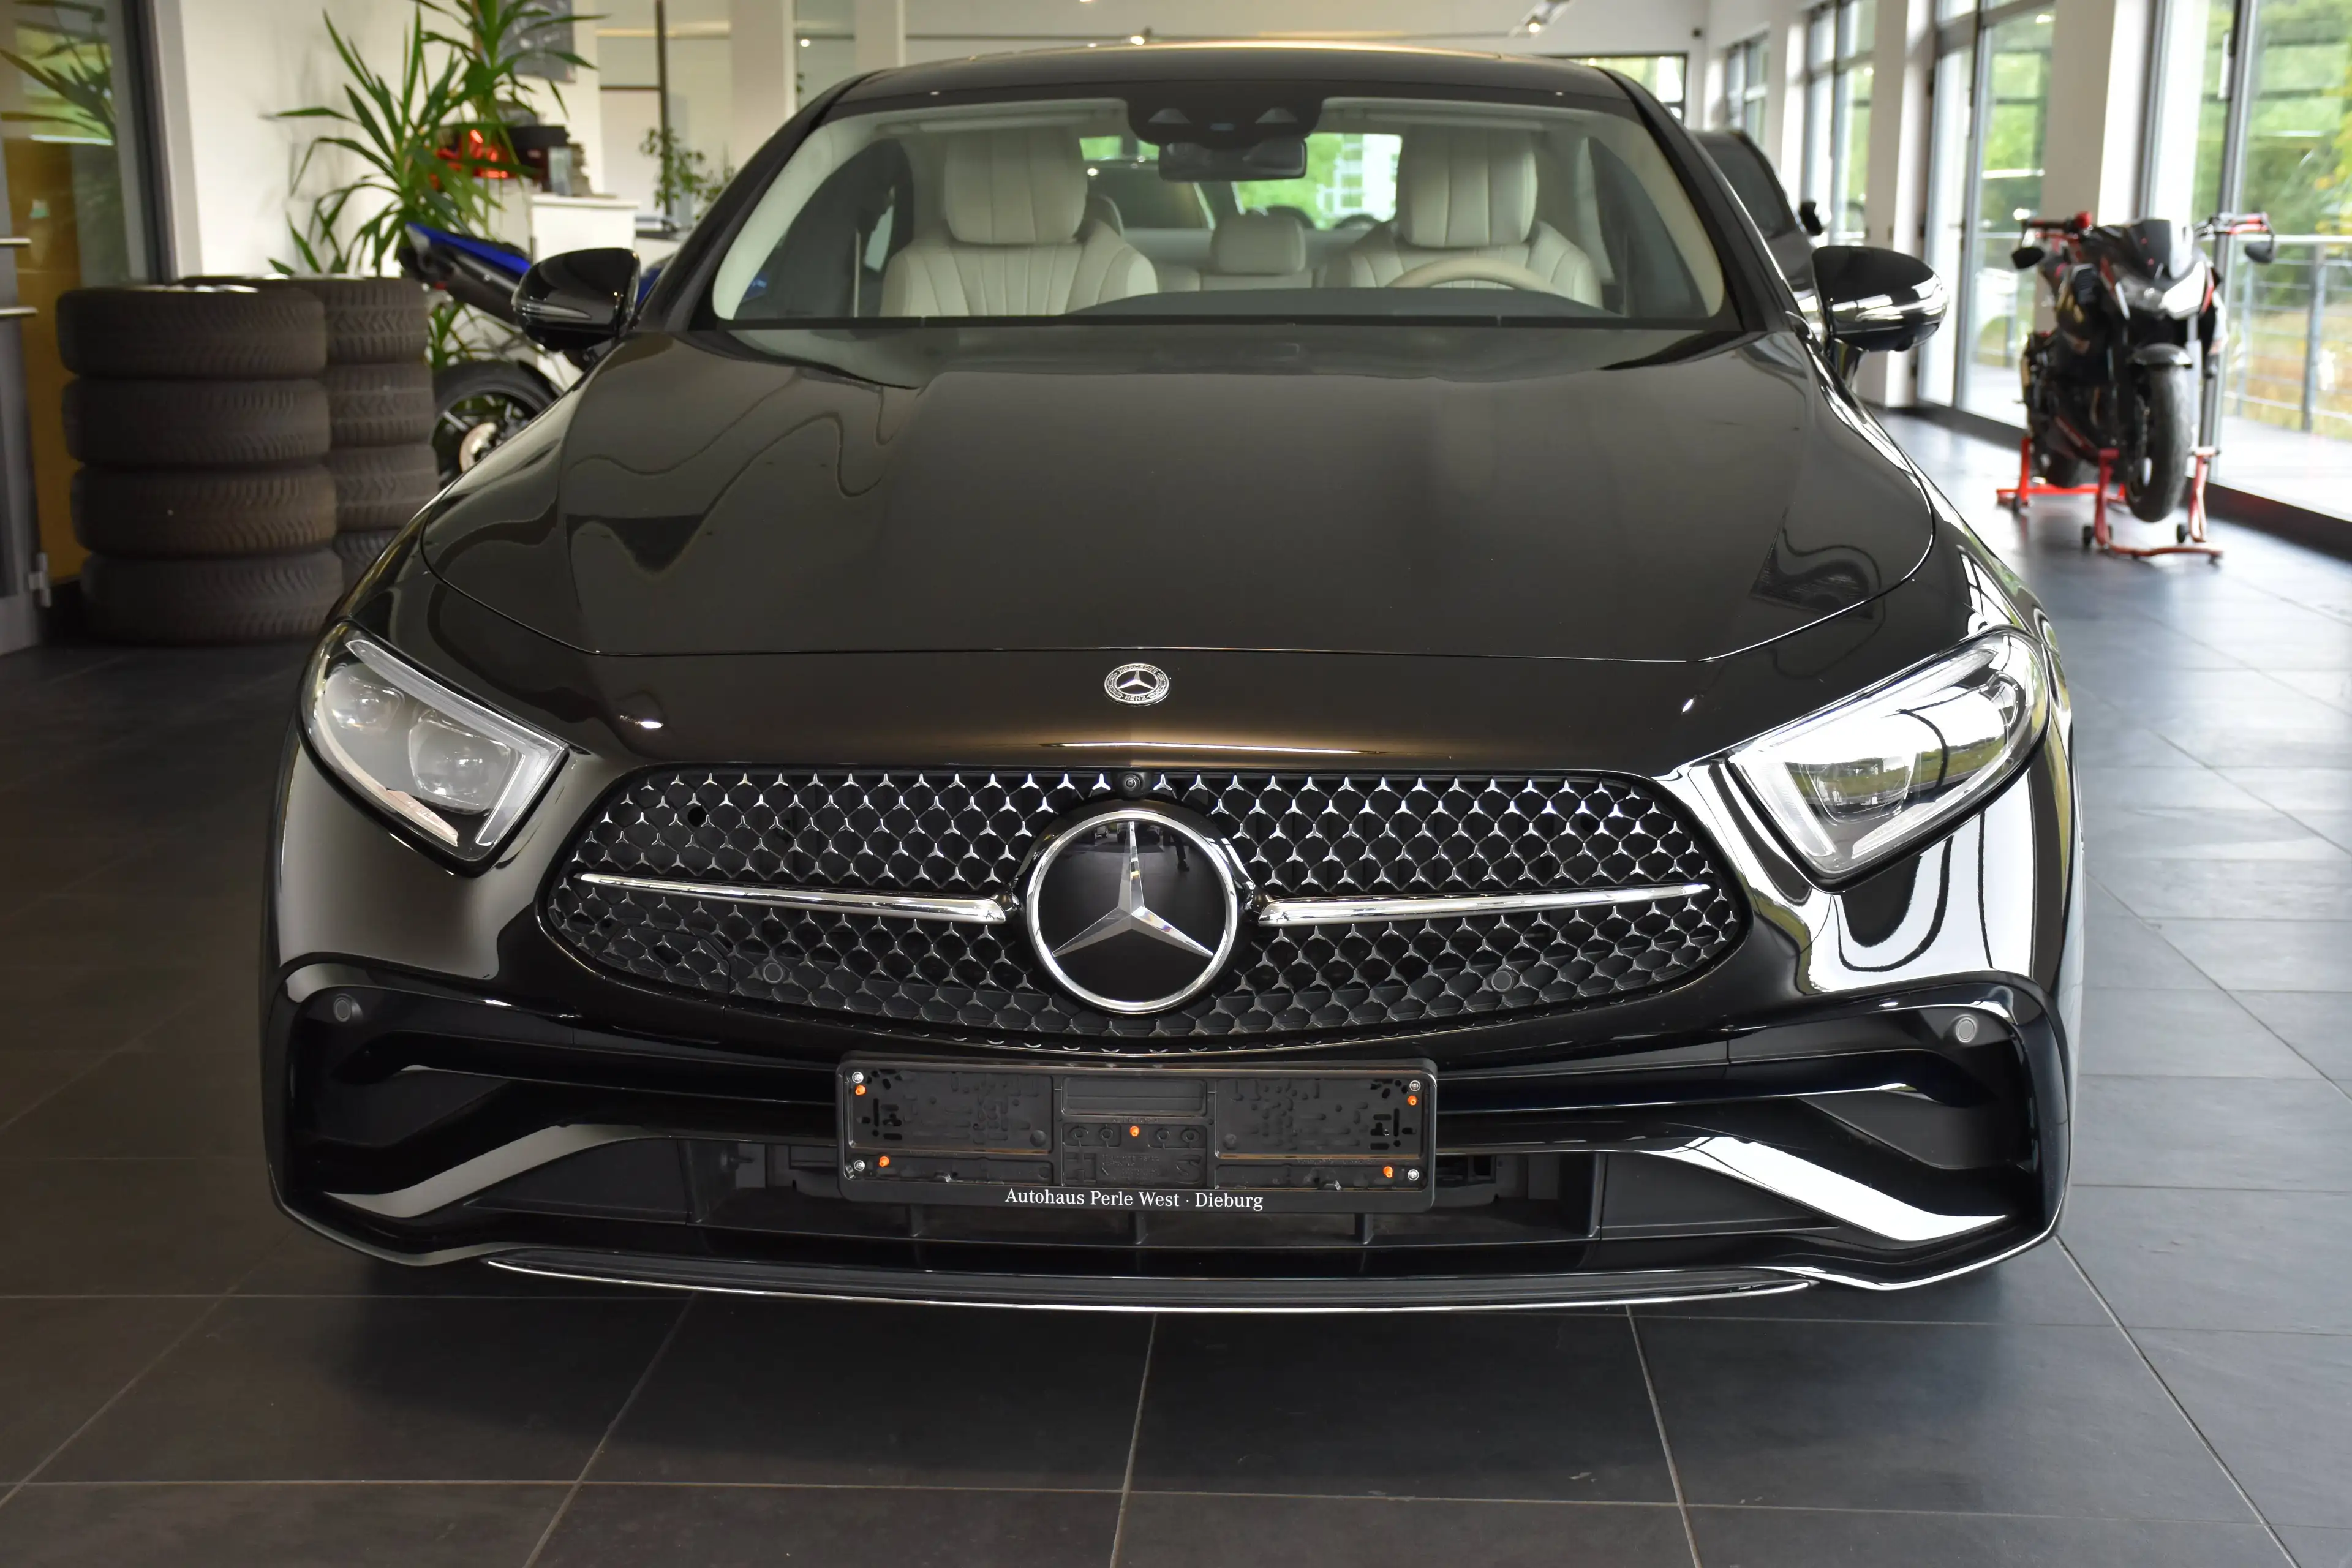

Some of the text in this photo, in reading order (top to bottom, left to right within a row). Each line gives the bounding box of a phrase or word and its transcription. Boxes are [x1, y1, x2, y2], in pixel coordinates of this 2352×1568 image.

[1118, 665, 1159, 673] MERCEDES
[1005, 1188, 1264, 1212] Autohaus Perle West Dieburg
